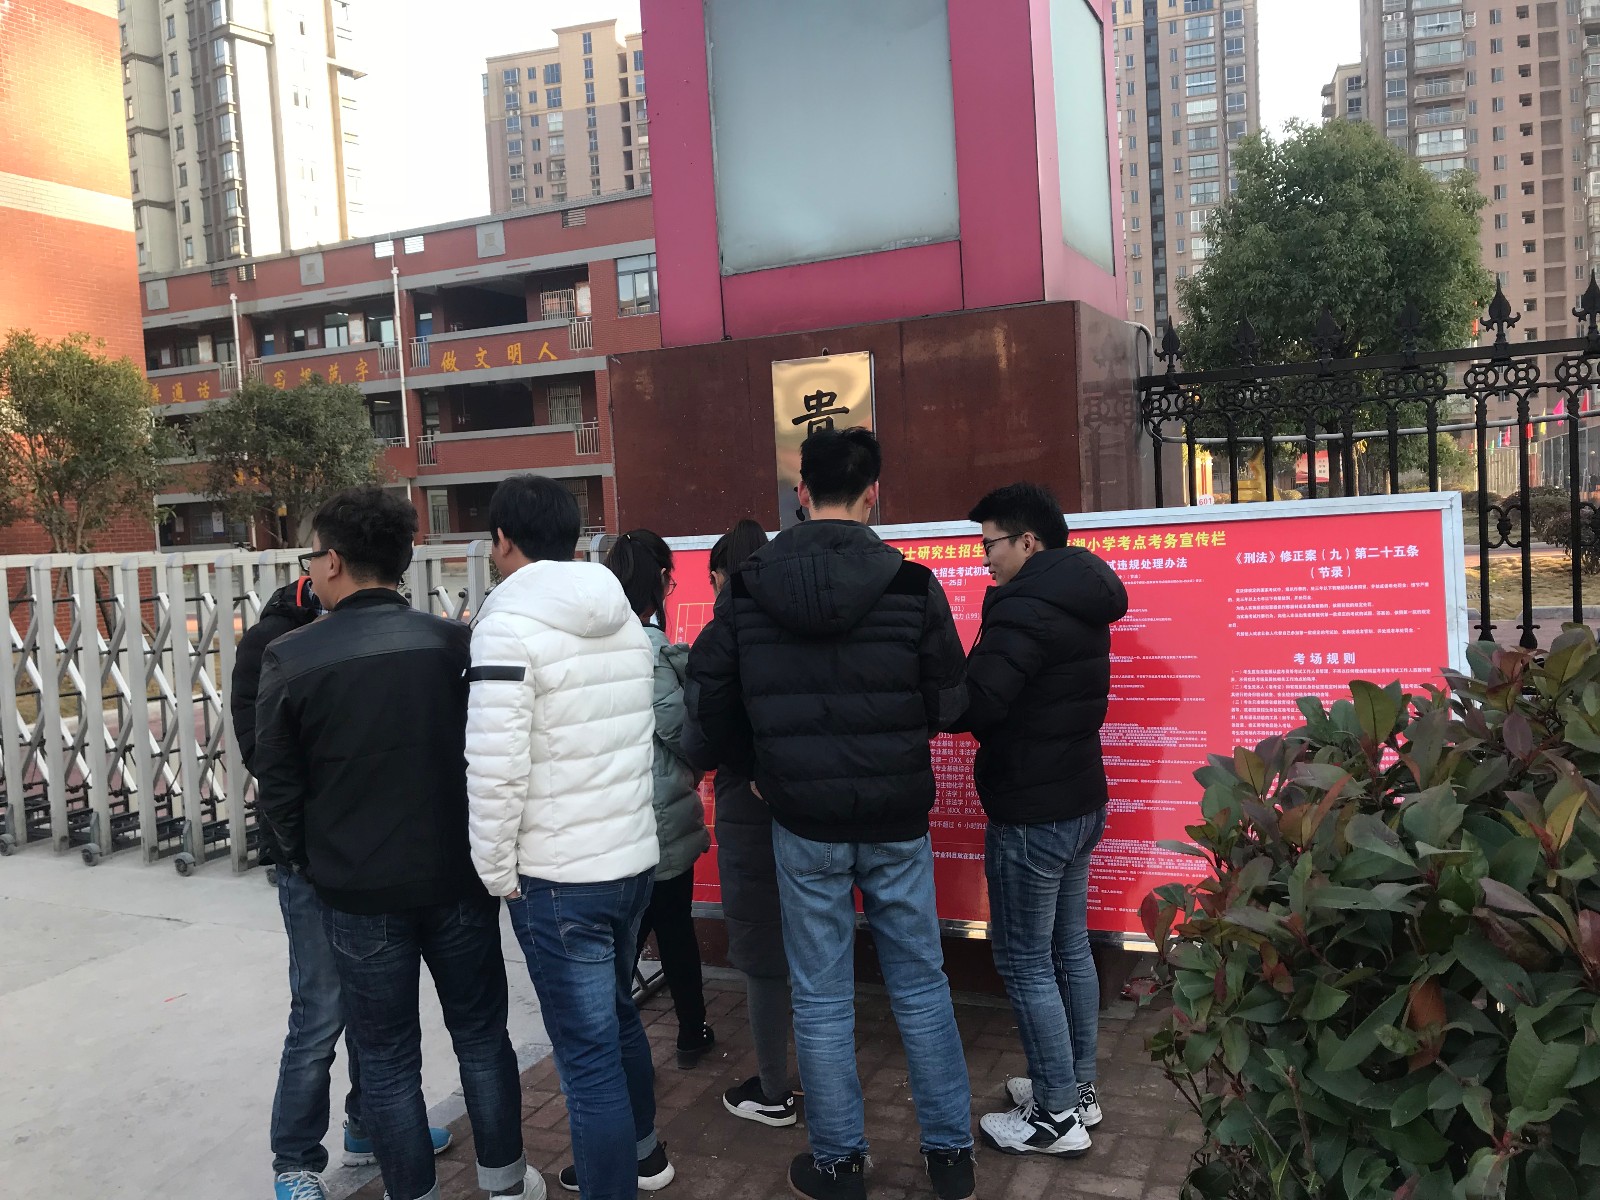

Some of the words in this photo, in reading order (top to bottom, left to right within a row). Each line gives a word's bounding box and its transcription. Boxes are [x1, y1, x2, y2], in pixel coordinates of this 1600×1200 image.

[441, 341, 558, 373] 做文明人
[791, 389, 850, 440] 贵
[1198, 497, 1213, 506] 601
[897, 543, 985, 561] 士研究生招生
[1234, 544, 1420, 565] 《刑法》修正案（九）第二十五条
[1310, 565, 1351, 579] （节录）
[1293, 652, 1356, 665] 考场规则
